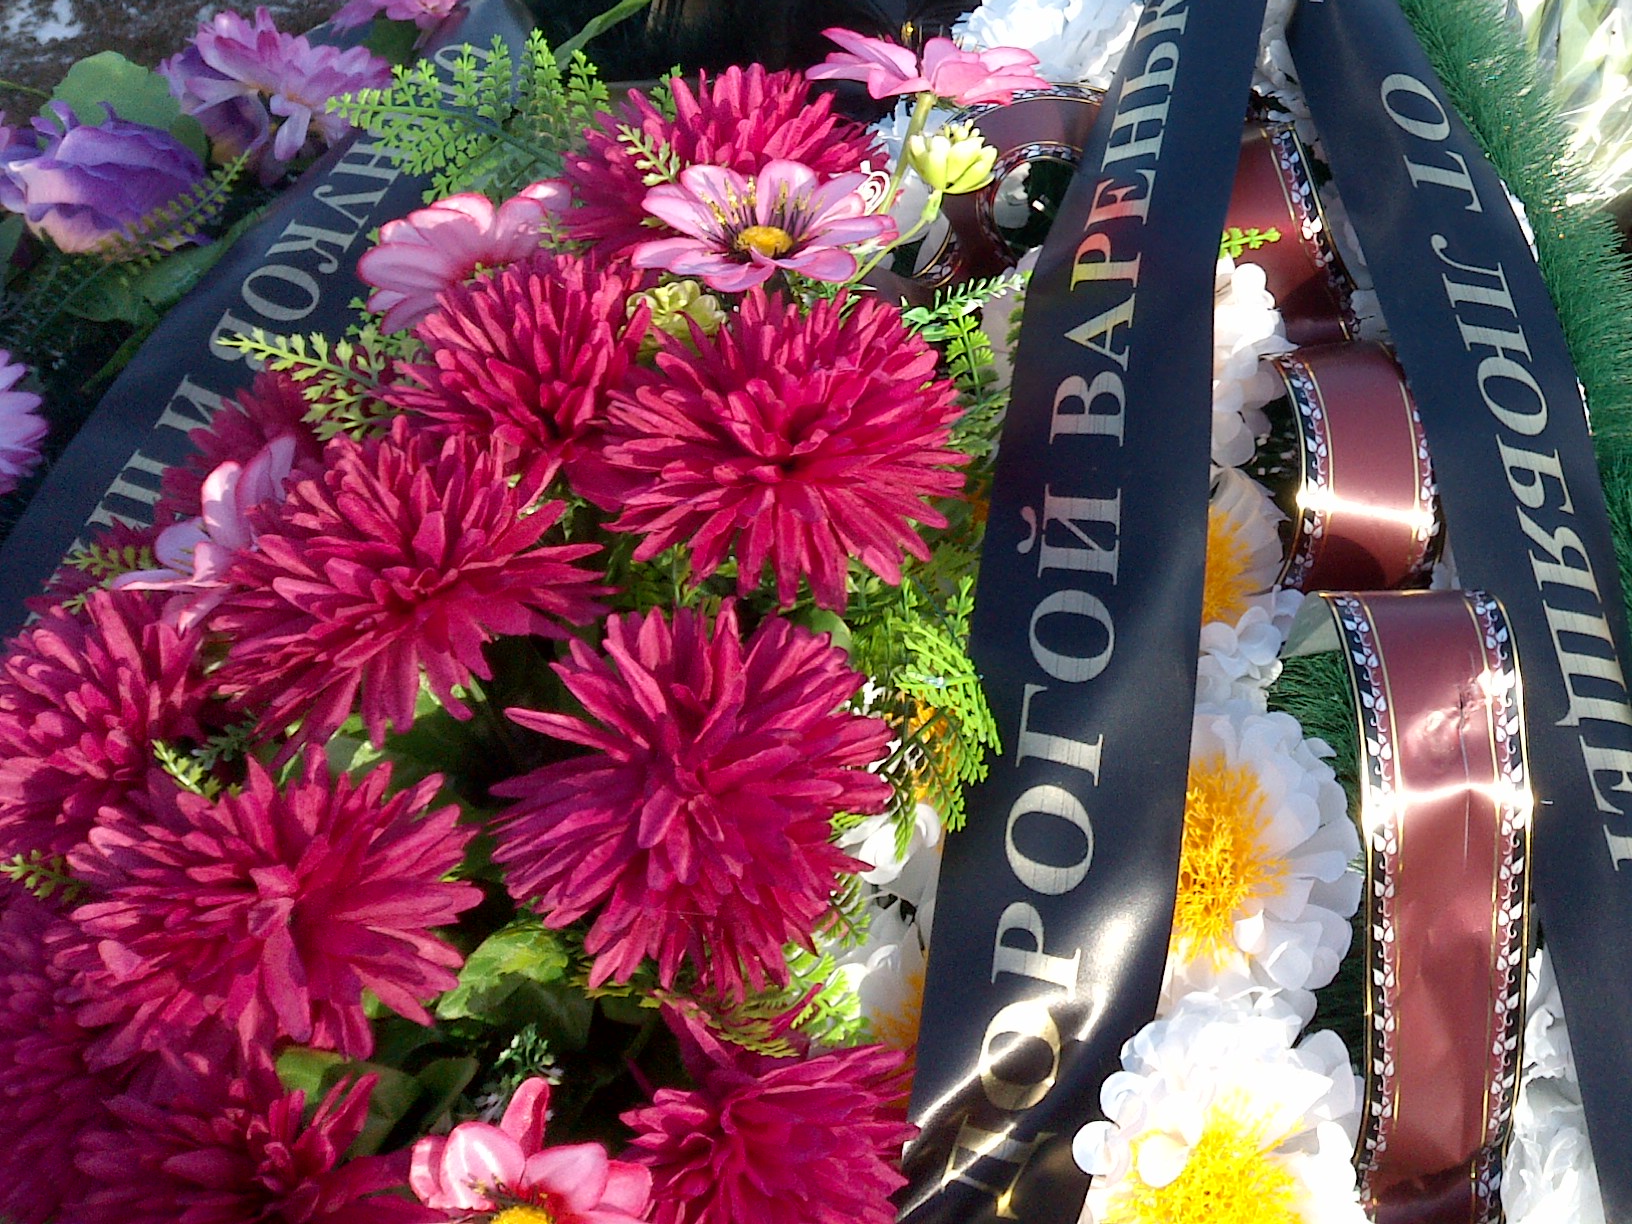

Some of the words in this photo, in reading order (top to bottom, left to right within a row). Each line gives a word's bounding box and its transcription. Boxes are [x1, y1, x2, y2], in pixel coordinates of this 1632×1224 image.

[208, 114, 422, 373] НУКОВ
[1380, 72, 1483, 213] ОТ
[941, 484, 1122, 1219] ДОРОГОЙ
